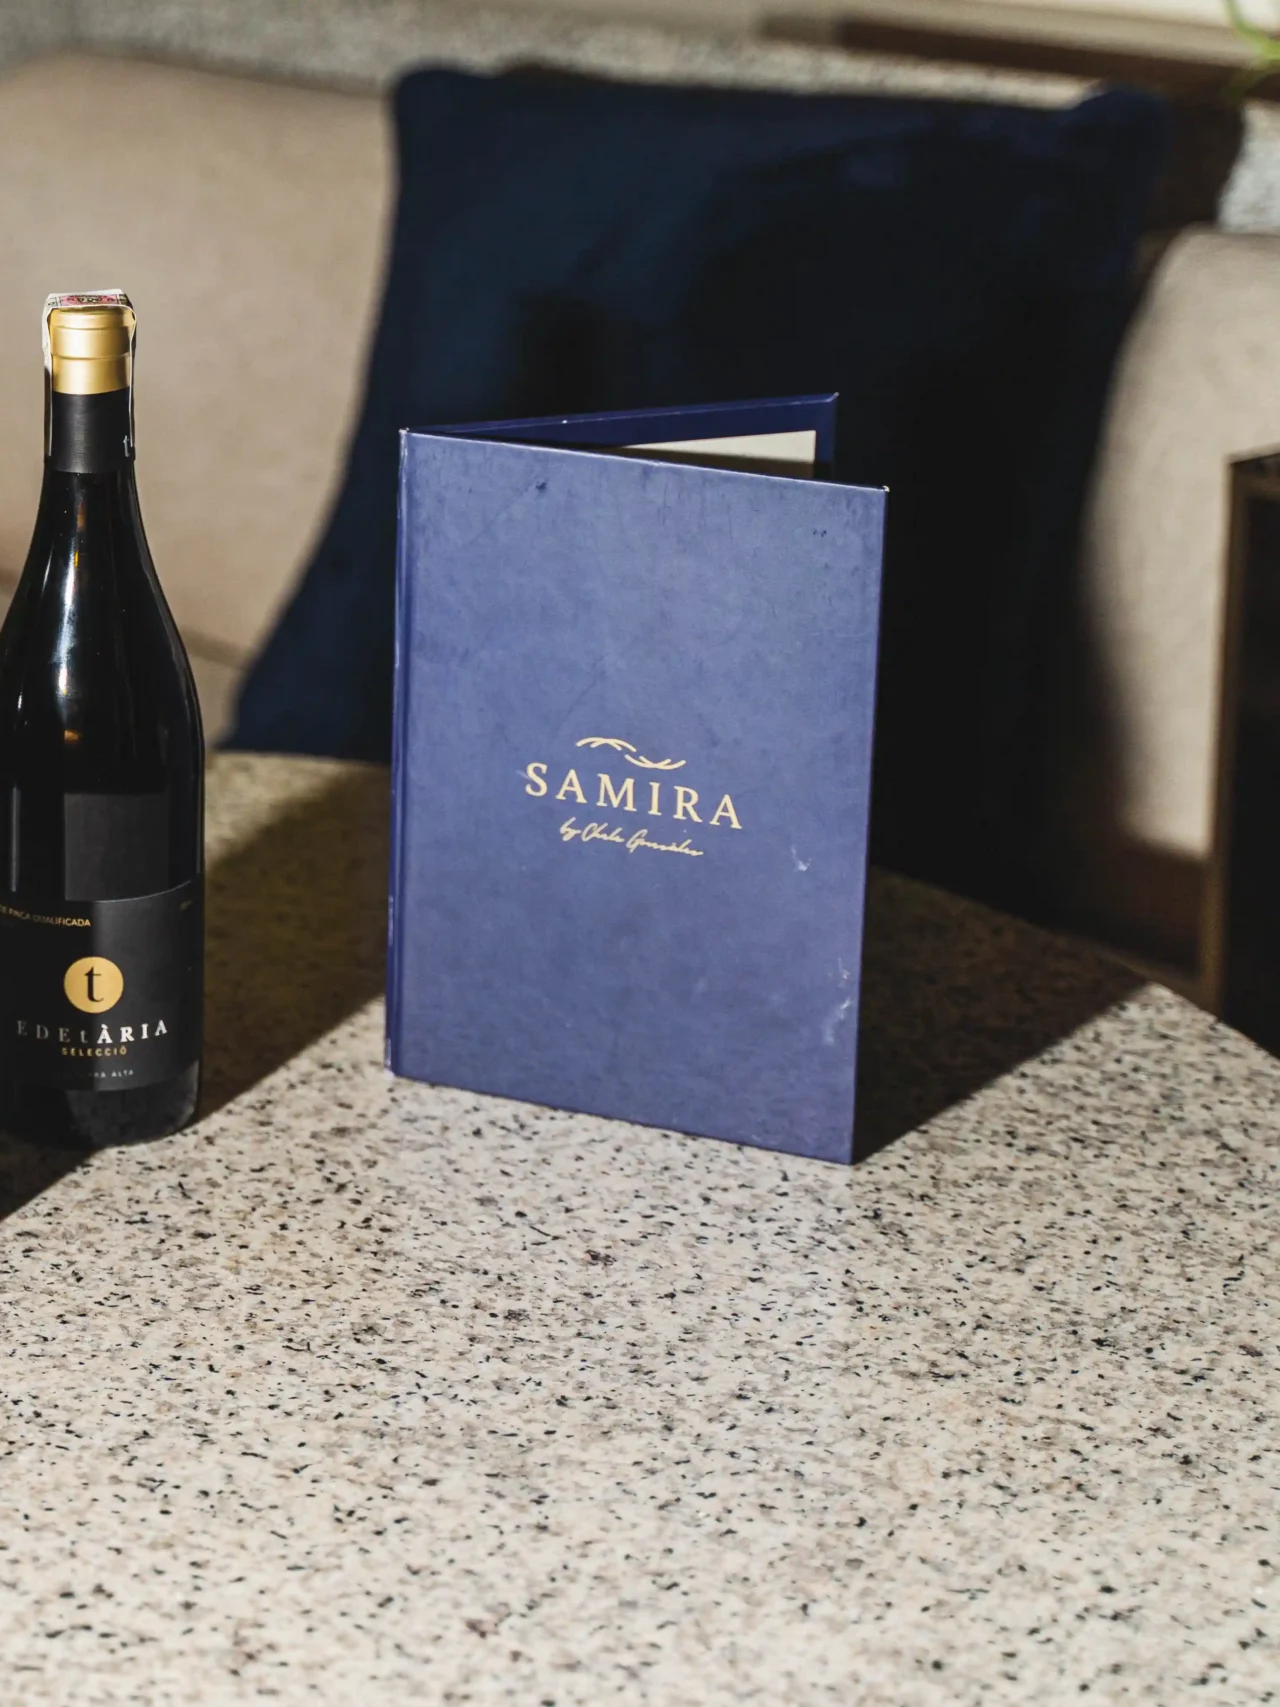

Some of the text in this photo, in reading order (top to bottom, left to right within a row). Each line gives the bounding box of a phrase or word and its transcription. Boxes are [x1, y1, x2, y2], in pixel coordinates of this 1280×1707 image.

[524, 762, 743, 829] SAMIRA
[560, 817, 581, 841] by
[84, 966, 104, 1002] t
